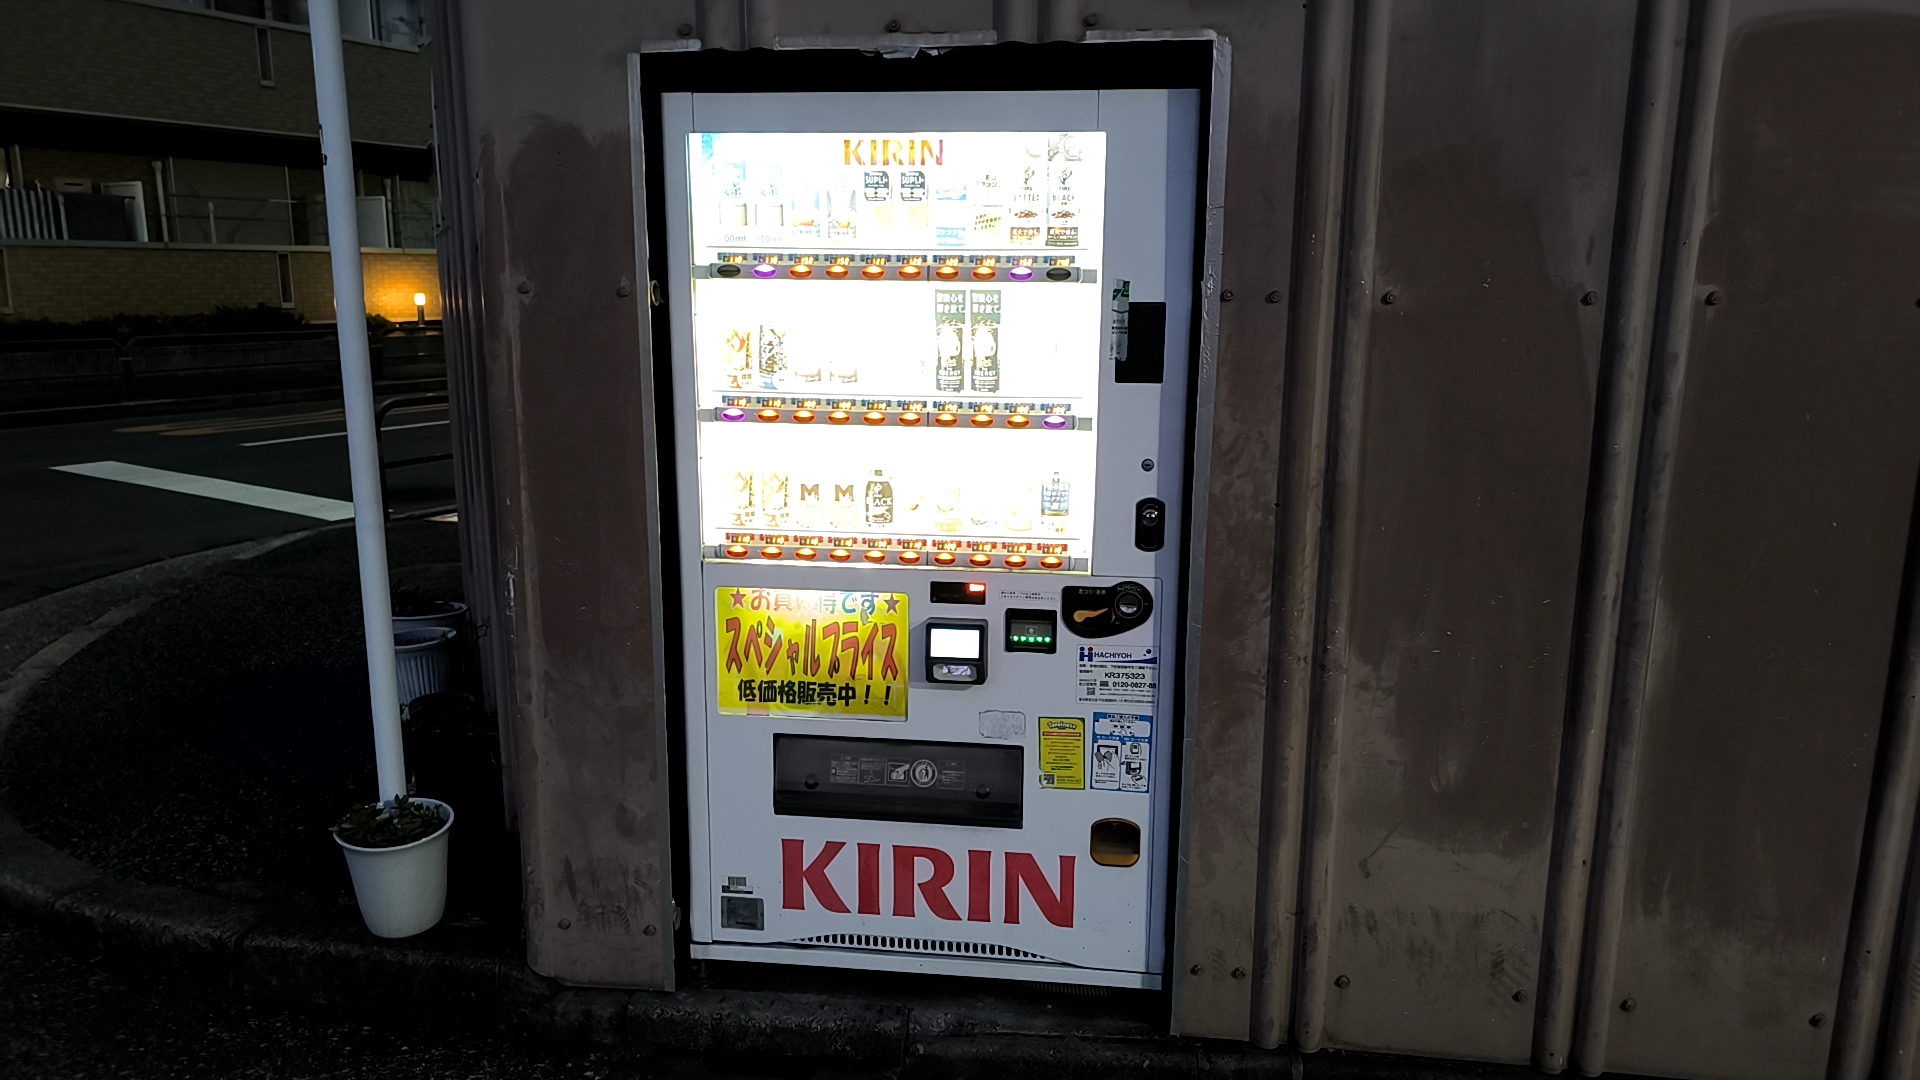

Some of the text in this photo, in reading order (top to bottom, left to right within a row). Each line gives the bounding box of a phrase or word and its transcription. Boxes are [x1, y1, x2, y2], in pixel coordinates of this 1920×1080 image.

[843, 139, 944, 166] KIRIN
[725, 615, 899, 681] スペシャルプライス
[1094, 652, 1132, 660] HACHIYOH
[1104, 672, 1146, 680] KR375323
[780, 838, 1076, 929] KIRIN
